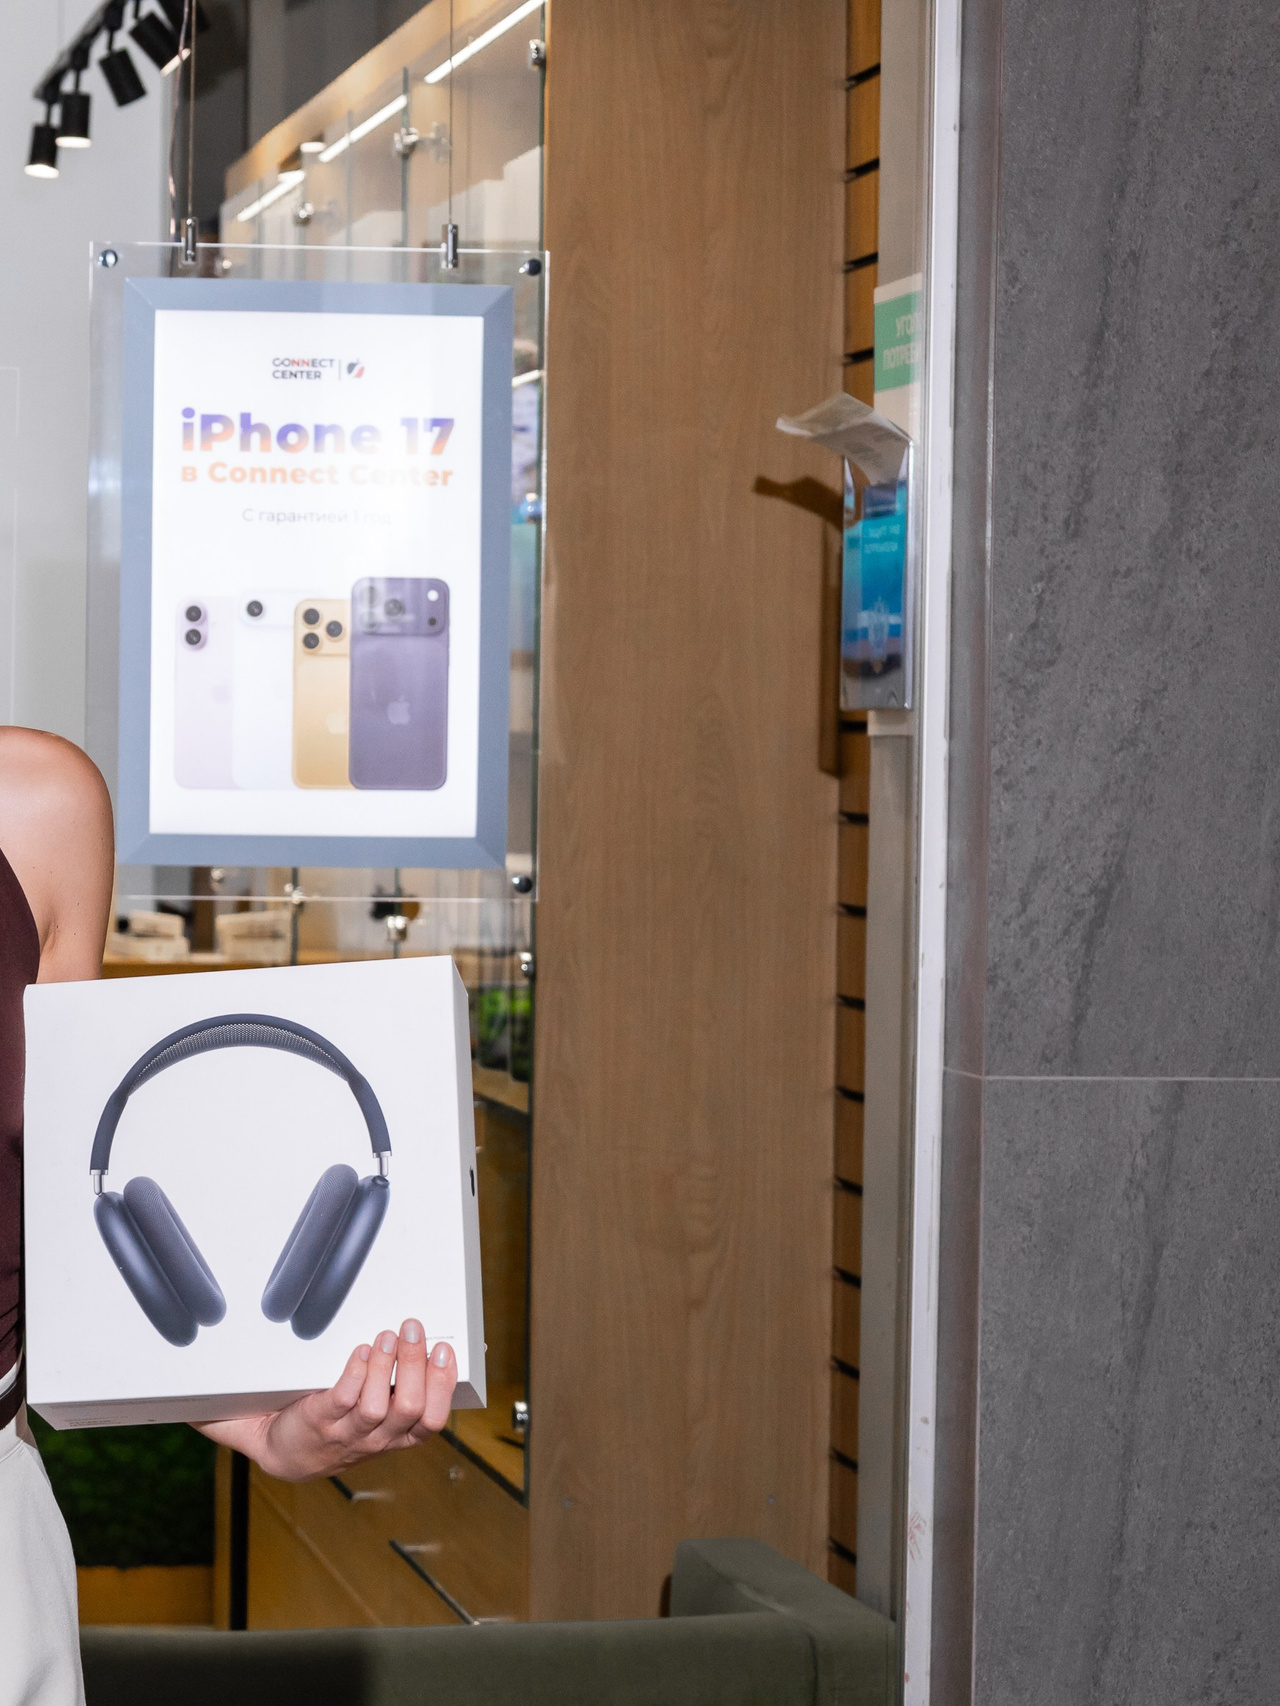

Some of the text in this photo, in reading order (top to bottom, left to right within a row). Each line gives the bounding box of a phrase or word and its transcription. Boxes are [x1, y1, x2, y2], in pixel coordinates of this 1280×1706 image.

[272, 358, 335, 368] CONNECT
[272, 370, 322, 379] CENTER
[181, 407, 455, 455] iPhone 17
[208, 461, 338, 484] Connect
[350, 464, 453, 487] Center
[259, 509, 348, 525] гарантией
